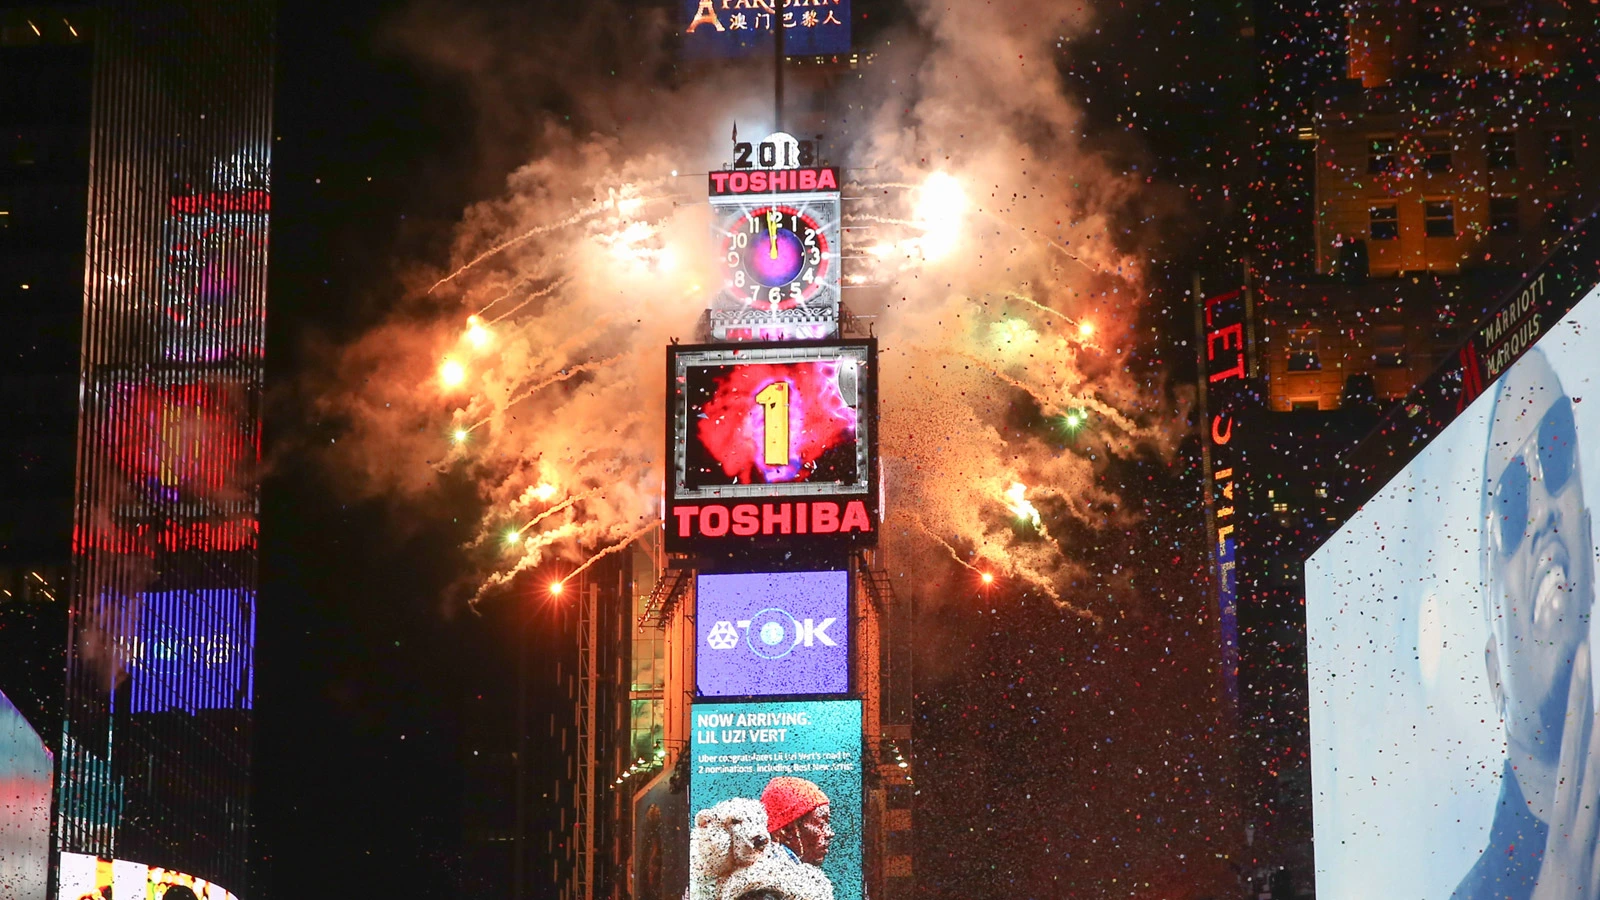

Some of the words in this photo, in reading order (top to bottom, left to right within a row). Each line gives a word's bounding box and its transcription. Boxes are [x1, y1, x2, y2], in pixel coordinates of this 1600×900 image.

[729, 10, 842, 30] 澳门巴黎人
[734, 142, 814, 168] 2018
[711, 168, 837, 193] TOSHIBA
[748, 217, 760, 233] 11
[767, 211, 783, 228] 2
[791, 216, 797, 232] 1
[730, 233, 747, 250] 10
[804, 229, 815, 246] 2
[727, 251, 739, 267] 9
[809, 247, 820, 265] 3
[734, 271, 745, 287] 8
[802, 267, 814, 284] 4
[750, 285, 760, 301] 7
[768, 287, 781, 303] 6
[790, 282, 801, 298] 5
[1485, 273, 1545, 347] MARRIOTT
[1486, 313, 1541, 379] MARQUIS
[755, 382, 789, 466] 1
[673, 501, 870, 537] TOSHIBA
[697, 714, 734, 727] NOW
[736, 712, 812, 726] ARRIVING:
[697, 730, 719, 744] LIL
[749, 728, 788, 742] VERT
[698, 754, 717, 762] Uber
[698, 765, 704, 774] 2
